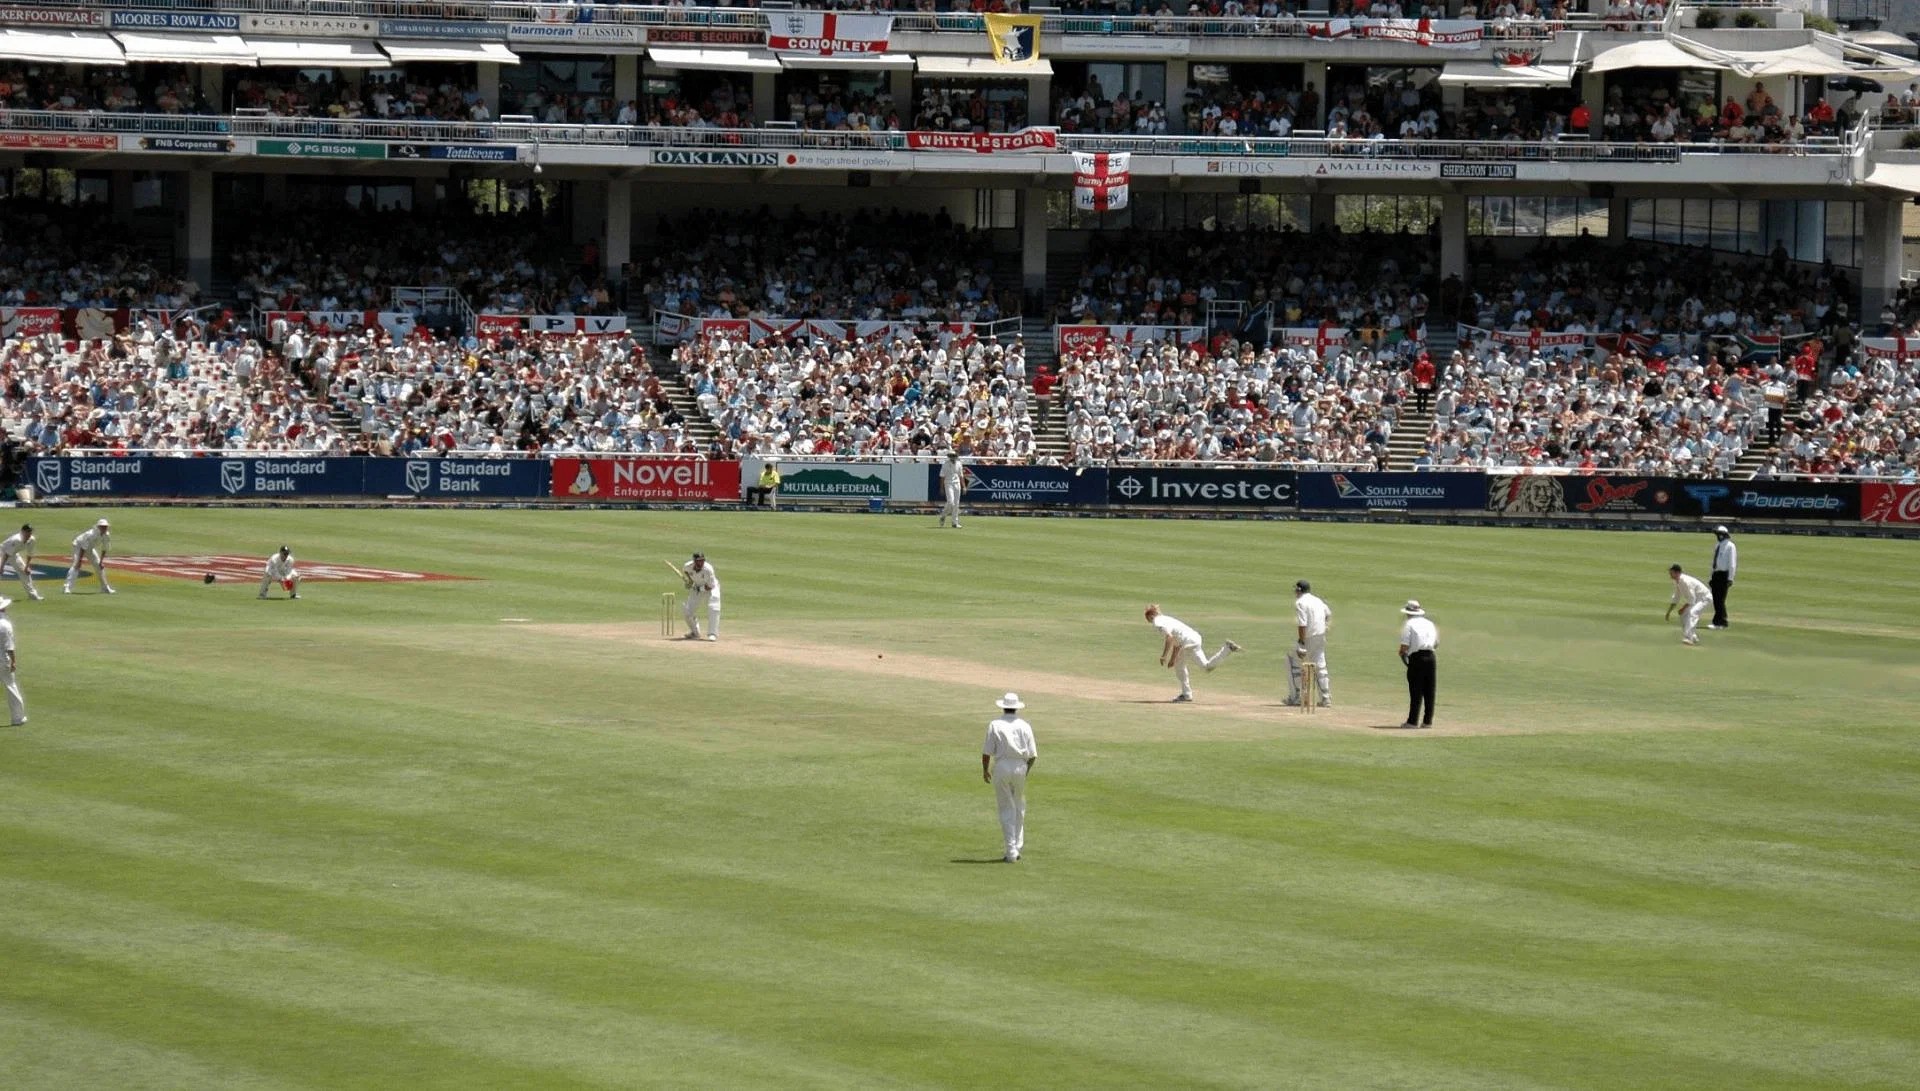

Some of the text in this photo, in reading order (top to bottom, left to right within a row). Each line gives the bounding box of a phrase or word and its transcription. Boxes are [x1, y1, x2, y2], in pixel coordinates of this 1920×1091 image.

[115, 13, 236, 27] MOORES ROWLAND
[511, 25, 573, 36] Marmoran
[662, 30, 759, 42] CORE SECURITY
[1447, 31, 1479, 42] TOWN
[788, 39, 871, 52] CONONLEY
[155, 138, 218, 150] FNB Corporate
[919, 133, 1044, 148] WHITTLESFORD
[304, 145, 356, 154] PG BISON
[657, 151, 777, 165] OAKLANDS
[1081, 157, 1122, 167] PRCE
[1443, 164, 1514, 177] SHERATON LINEN
[1082, 194, 1119, 204] HARY
[546, 318, 611, 331] P V
[1531, 335, 1563, 346] VILLA
[1564, 335, 1580, 345] FC
[70, 459, 141, 473] Standard
[255, 460, 326, 474] Standard
[440, 461, 511, 475] Standard
[614, 461, 708, 485] Novell
[70, 476, 111, 491] Bank
[255, 476, 296, 491] Bank
[439, 477, 480, 491] Bank
[783, 482, 882, 493] MUTUAL&FEDERAL
[991, 478, 1069, 489] SOUTH AFRICAN
[1151, 476, 1290, 500] Investec
[614, 486, 708, 498] Enterprise Linux
[991, 491, 1032, 500] AIRWAYS
[1366, 485, 1445, 496] SOUTH AFRICAN
[1366, 498, 1408, 507] AIRWAYS
[1742, 491, 1840, 509] Powerade
